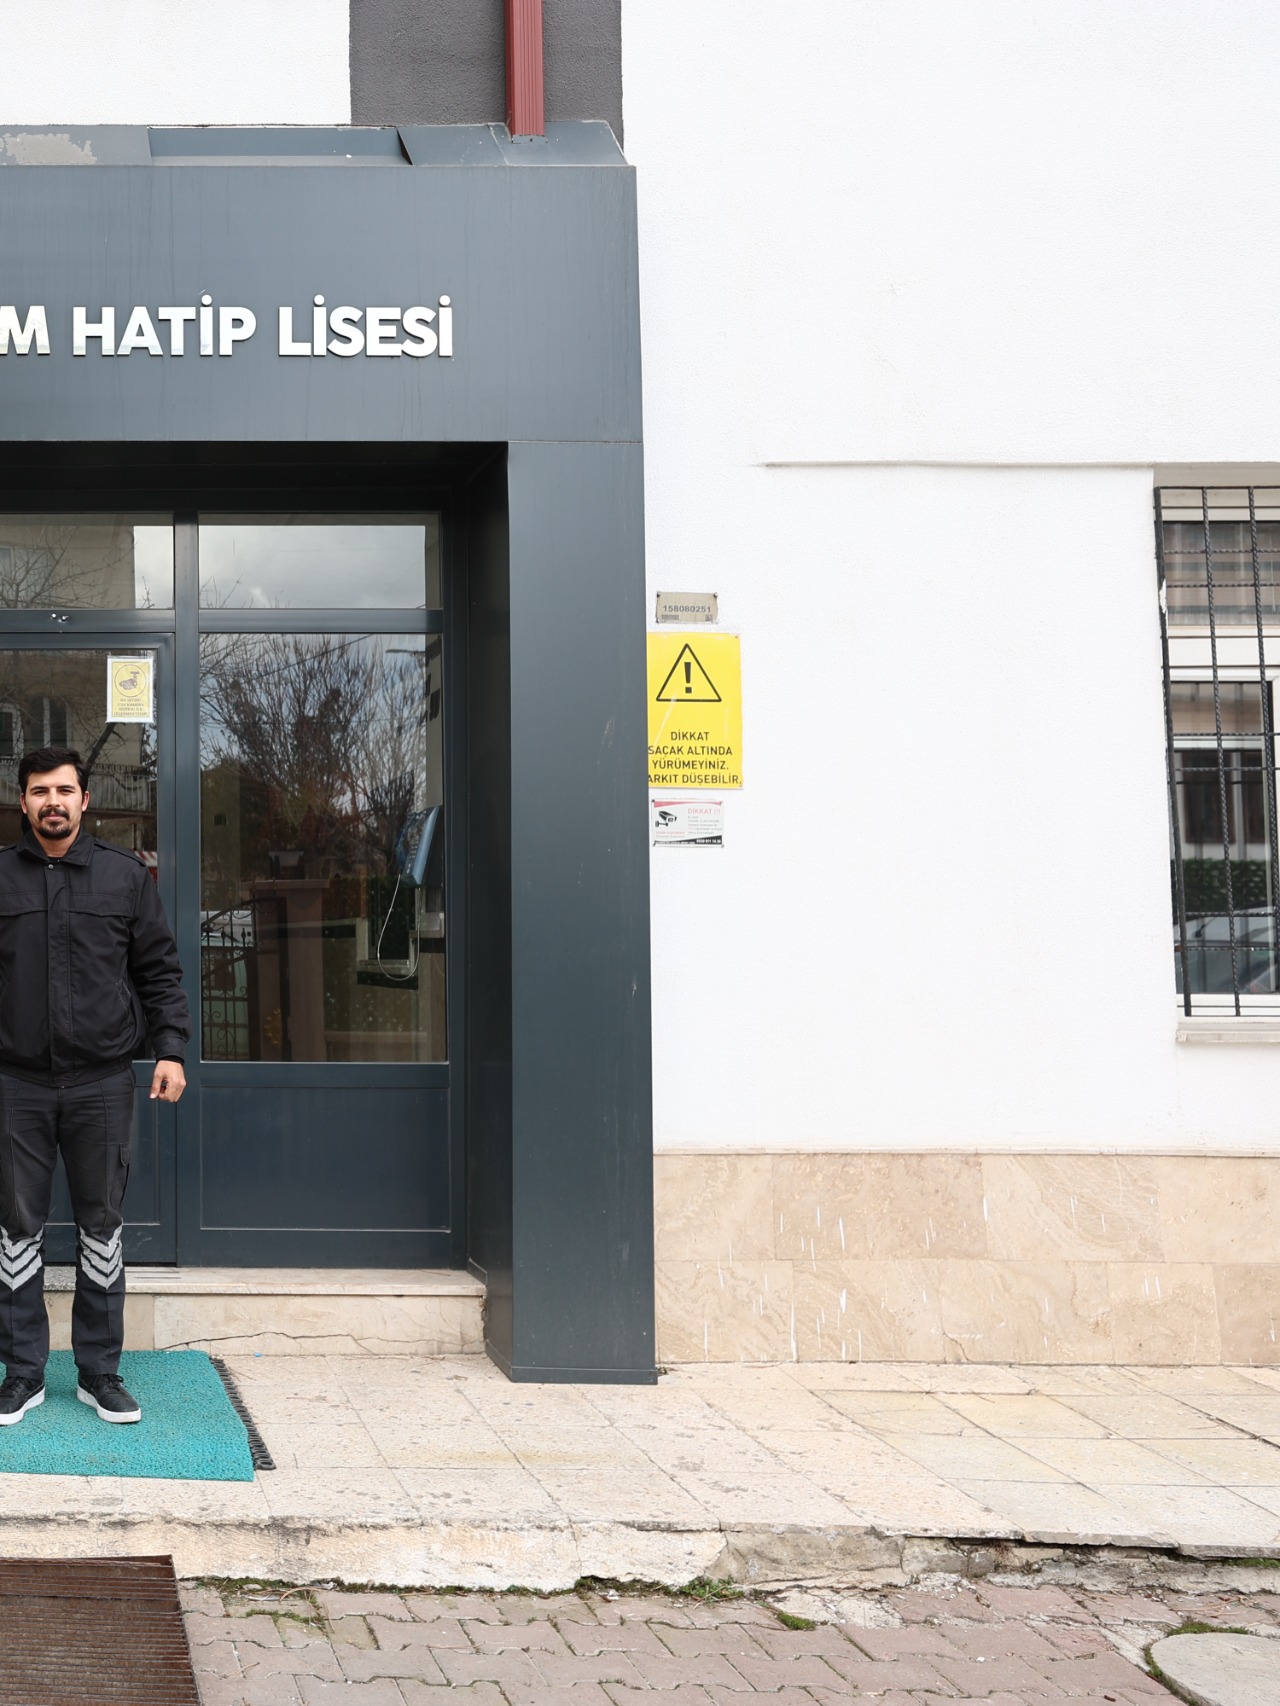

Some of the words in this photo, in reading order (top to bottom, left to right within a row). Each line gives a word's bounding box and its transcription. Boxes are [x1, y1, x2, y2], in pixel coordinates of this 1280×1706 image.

[72, 294, 257, 357] HATİP
[278, 294, 453, 357] LİSESİ
[662, 605, 711, 613] 158080251
[670, 729, 710, 741] DİKKAT
[648, 745, 684, 757] SAÇAK
[687, 746, 733, 755] ALTINDA
[652, 758, 729, 770] YÜRÜMEYİNİZ.
[648, 774, 678, 783] ARKIT
